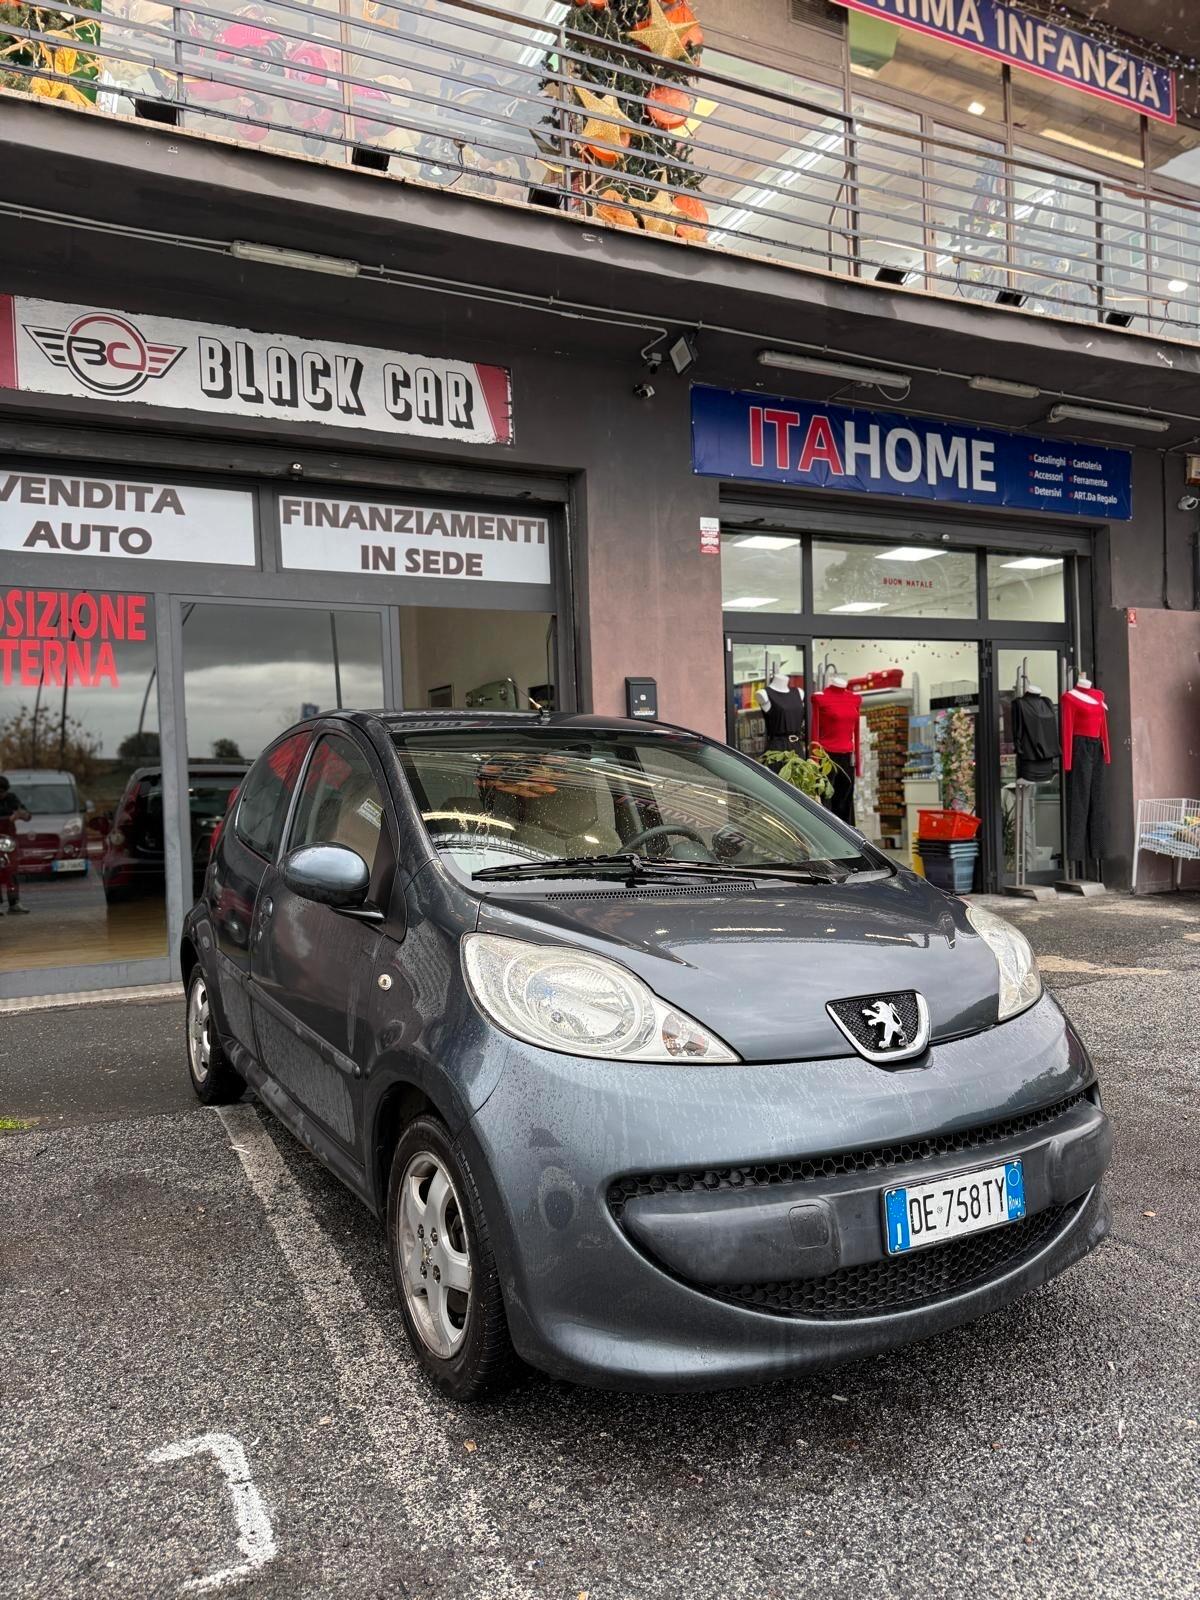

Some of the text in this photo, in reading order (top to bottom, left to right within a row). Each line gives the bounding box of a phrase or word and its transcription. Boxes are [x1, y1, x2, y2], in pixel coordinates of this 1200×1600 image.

[996, 8, 1161, 108] INFANZIA
[198, 336, 474, 430] BLACK CAR
[750, 406, 997, 492] ITAHOME
[1033, 453, 1066, 468] Casalinghi
[1073, 459, 1102, 471] Cartoleria
[1034, 470, 1064, 482] Accessori
[1034, 486, 1062, 498] Detersivi
[1073, 475, 1108, 488] Ferramenta
[1097, 495, 1118, 505] Regalo
[23, 520, 153, 555] AUTO
[282, 499, 546, 545] FINANZIAMENTI
[361, 545, 483, 577] IN SEDE
[883, 577, 932, 588] BUON NATALE
[0, 589, 146, 641] SIZIONE
[909, 1177, 1005, 1236] DE 758TY
